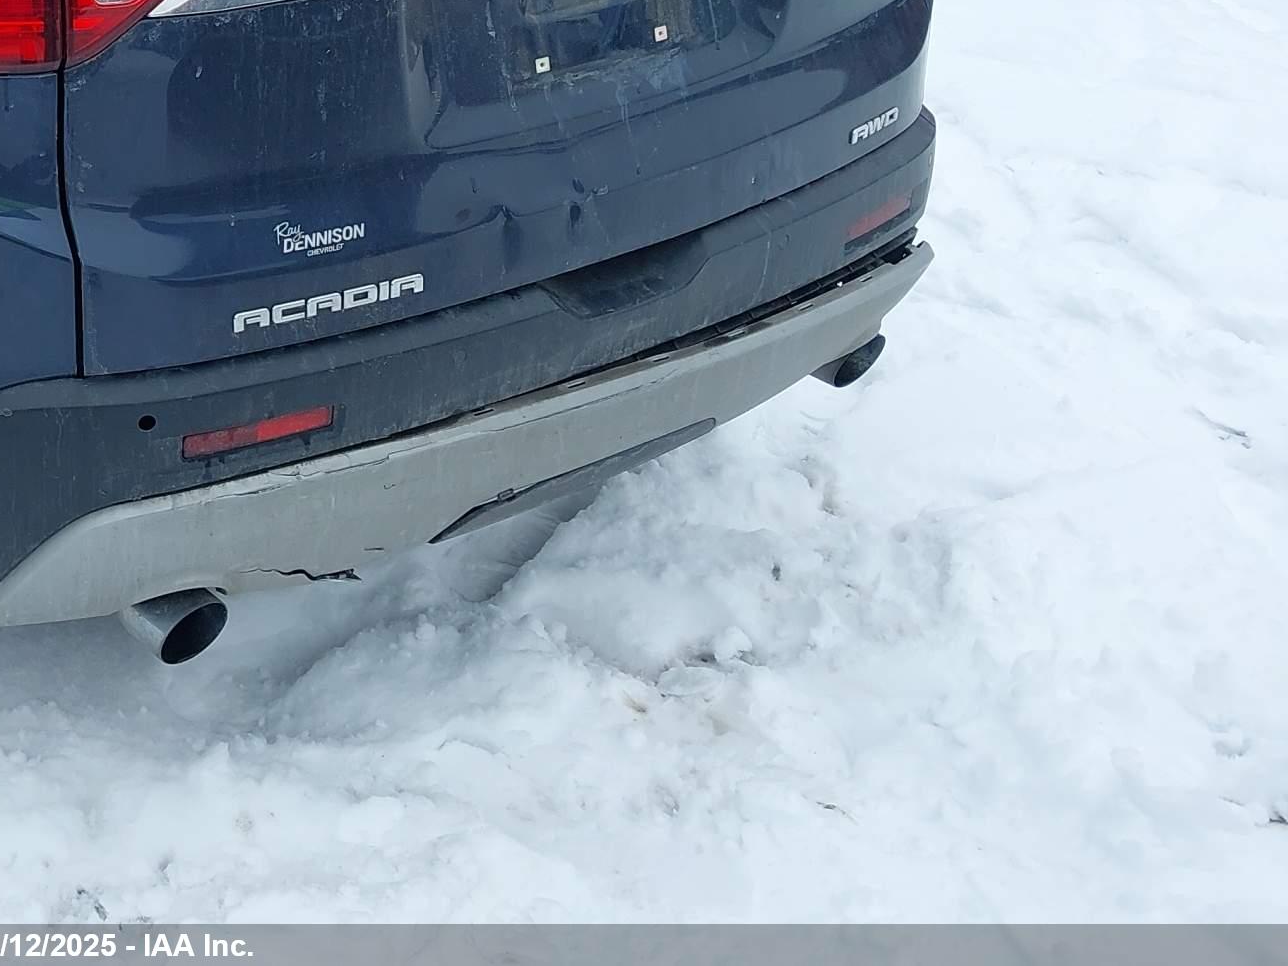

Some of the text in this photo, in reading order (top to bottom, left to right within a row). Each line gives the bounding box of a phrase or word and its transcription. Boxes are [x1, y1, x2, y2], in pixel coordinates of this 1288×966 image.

[850, 106, 900, 145] AWD
[273, 221, 305, 245] Ray
[283, 222, 366, 254] DENNISON
[306, 243, 345, 257] CHEVROLET
[233, 273, 424, 334] ACADIA
